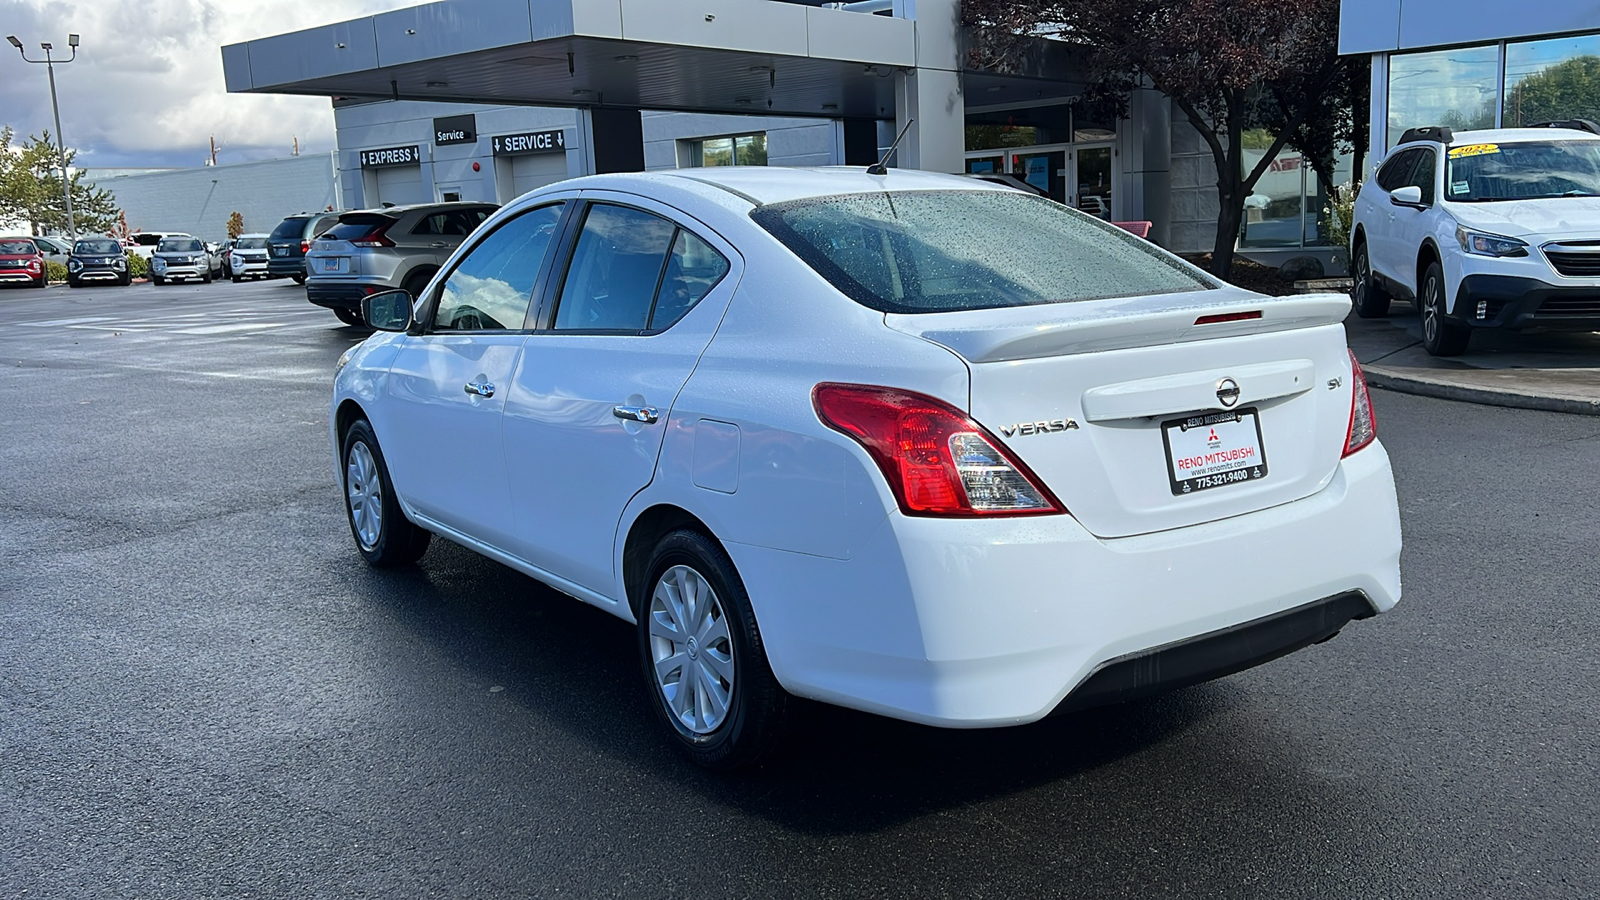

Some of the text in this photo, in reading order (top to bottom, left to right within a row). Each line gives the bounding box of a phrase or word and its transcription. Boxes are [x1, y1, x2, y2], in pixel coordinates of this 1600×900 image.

[437, 129, 464, 142] Service
[505, 134, 552, 152] SERVICE
[369, 149, 411, 165] EXPRESS
[1327, 376, 1342, 390] SV
[998, 417, 1080, 438] VERSA
[1187, 412, 1236, 427] RENO MITSUBISHI
[1178, 447, 1255, 470] RENO MITSUBISHI
[1190, 460, 1247, 476] www.renomits.com
[1196, 469, 1248, 488] 775-321-9400
